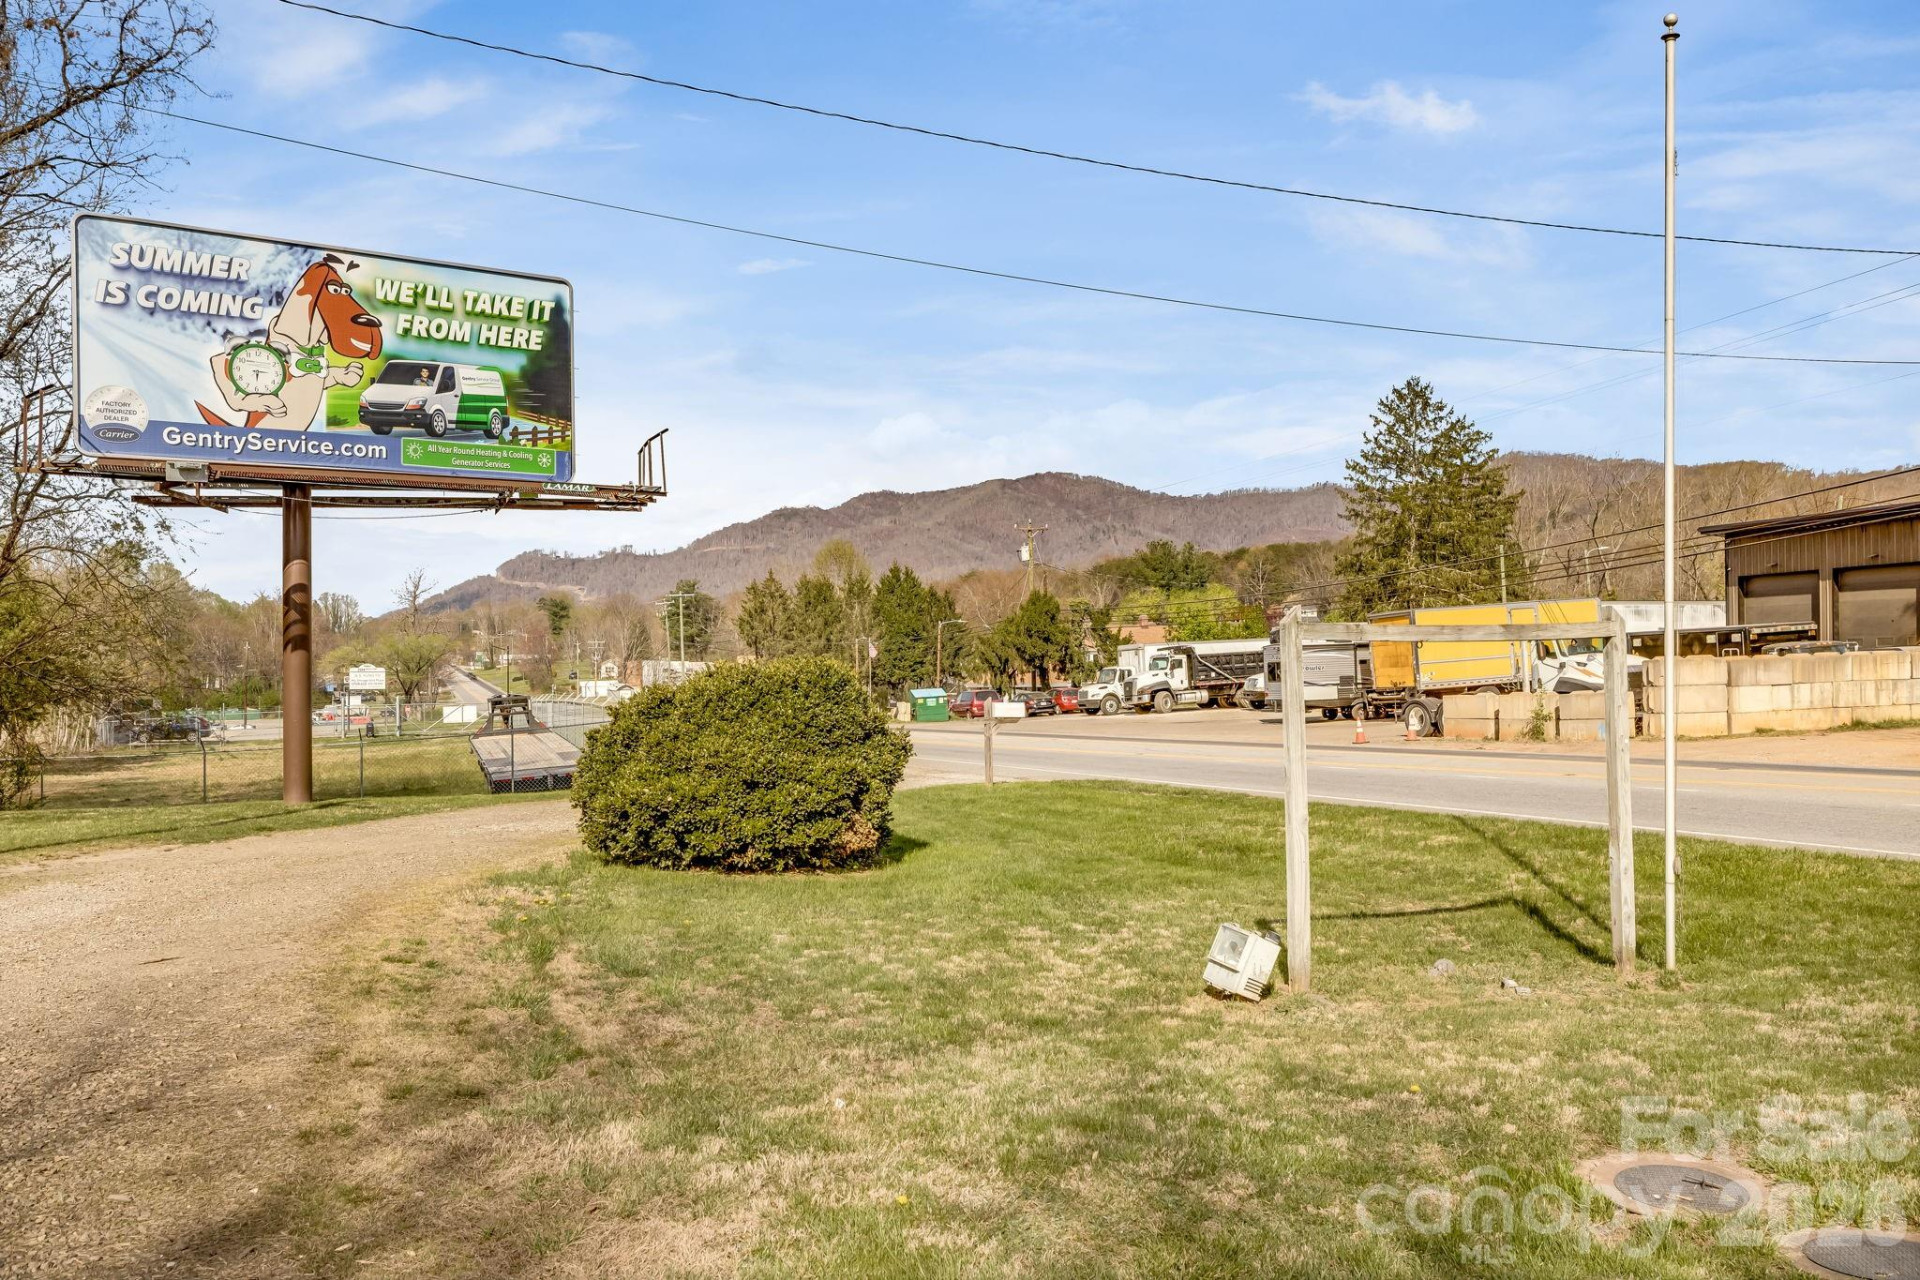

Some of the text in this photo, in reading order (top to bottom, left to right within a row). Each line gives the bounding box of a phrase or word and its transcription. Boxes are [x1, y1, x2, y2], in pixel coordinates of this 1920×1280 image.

[109, 242, 251, 282] SUMMER
[95, 279, 265, 320] IS COMING
[375, 278, 556, 322] WE'LL TAKE IT
[396, 313, 545, 351] FROM HERE
[95, 407, 138, 416] AUTHORIZED
[101, 400, 131, 408] FACTORY
[100, 429, 135, 439] Carrier
[162, 426, 388, 459] GentryService.com
[427, 444, 437, 452] All
[437, 445, 452, 454] Year
[453, 447, 475, 455] Round
[476, 448, 502, 459] Heating
[508, 451, 533, 461] Cooling
[451, 457, 511, 469] Generator Services
[546, 482, 591, 492] LAMAR
